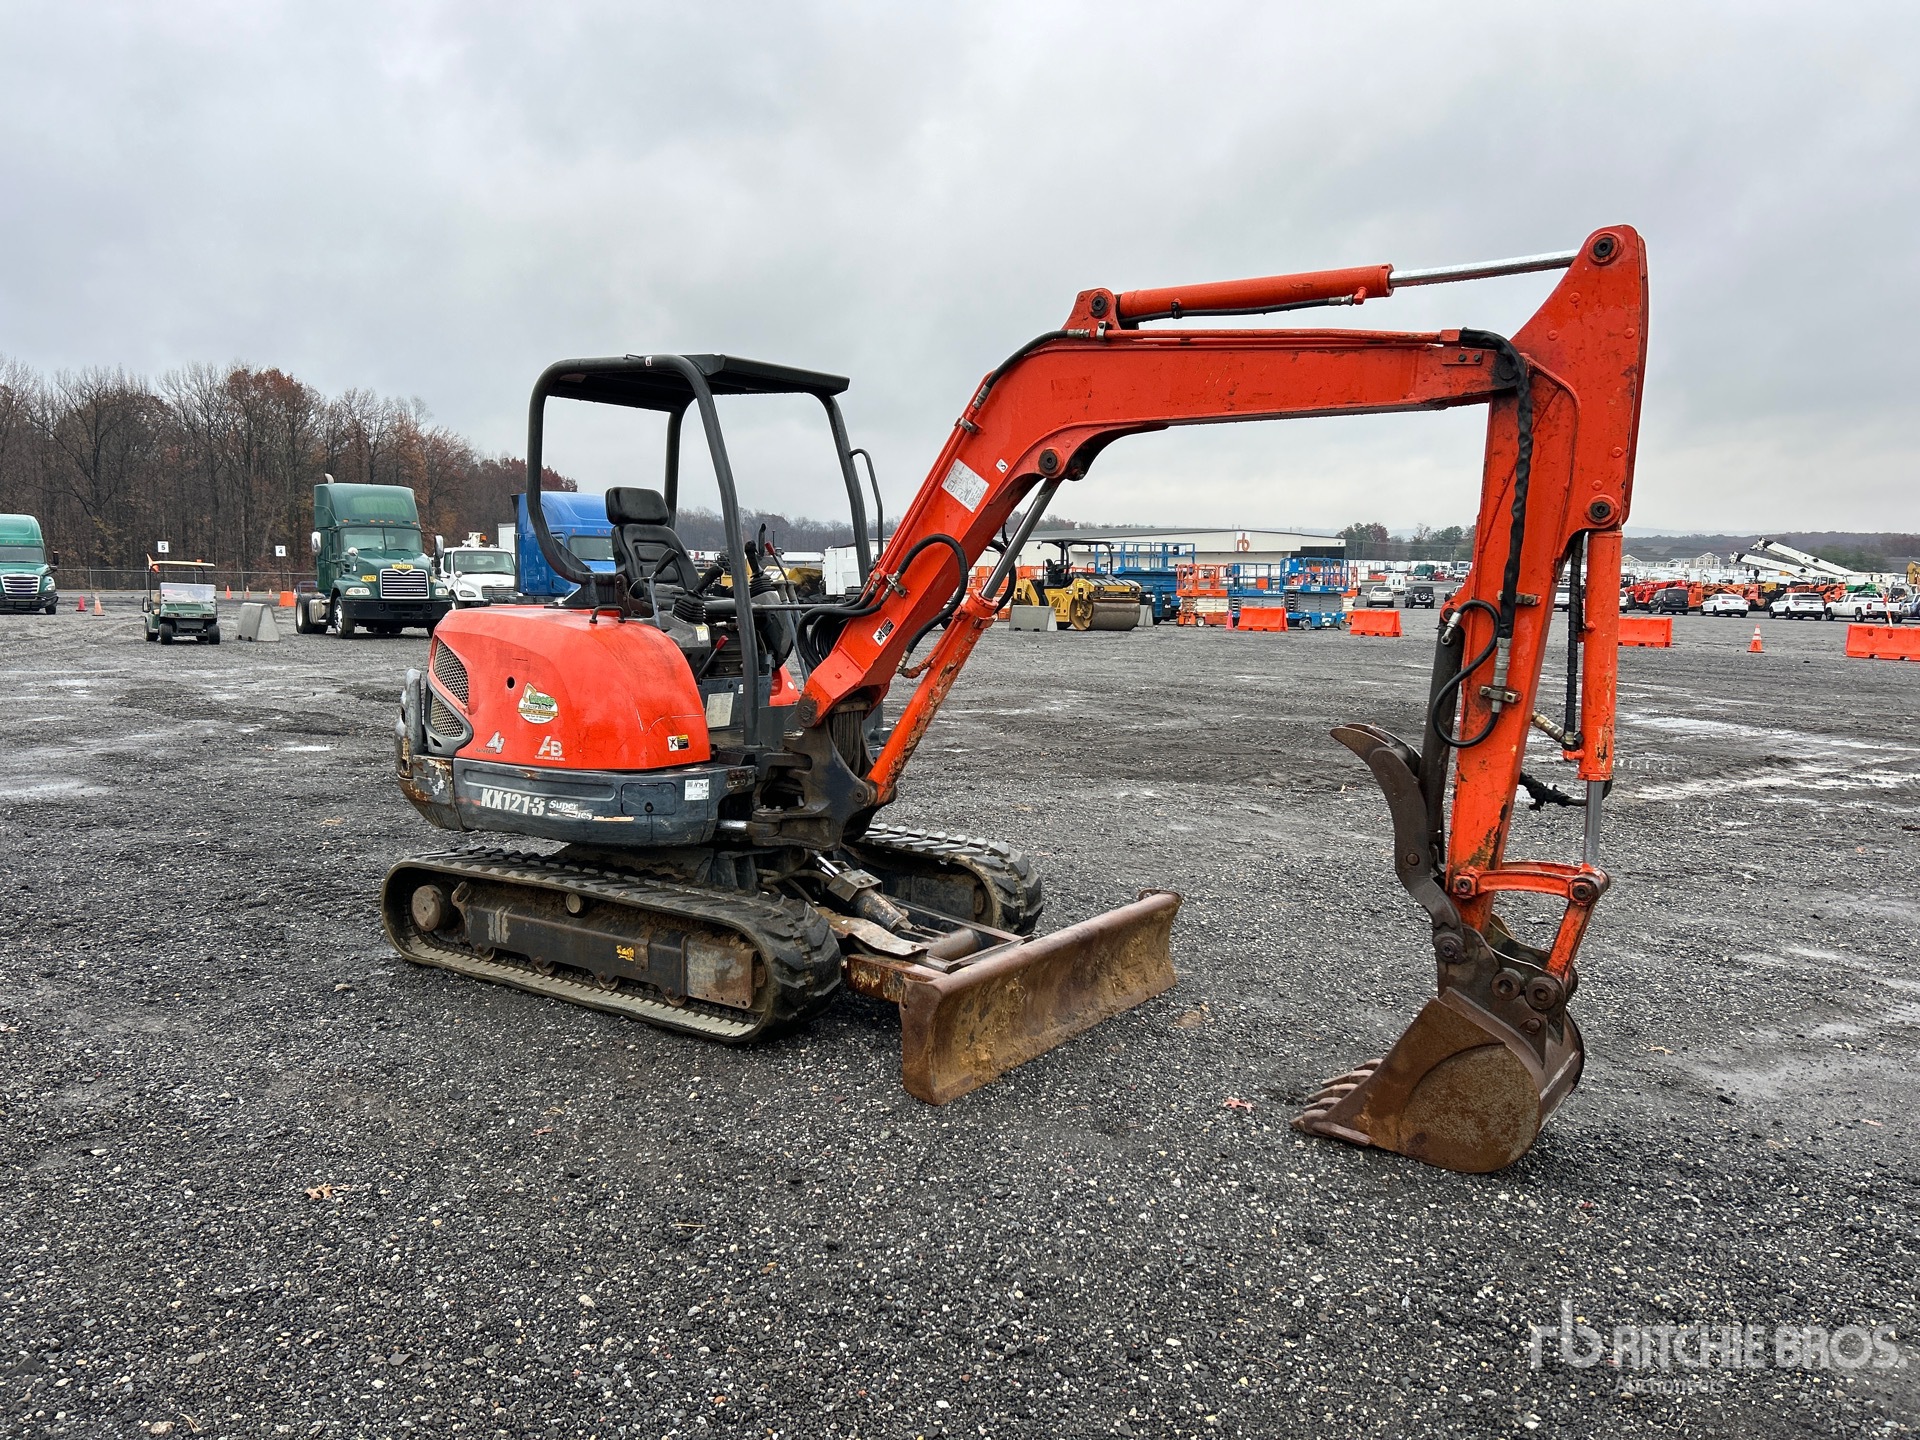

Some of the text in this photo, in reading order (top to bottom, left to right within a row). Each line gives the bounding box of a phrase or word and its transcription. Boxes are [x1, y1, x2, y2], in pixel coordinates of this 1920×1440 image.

[1236, 532, 1250, 552] rb
[480, 788, 546, 817] KX121-3
[549, 800, 579, 811] Super
